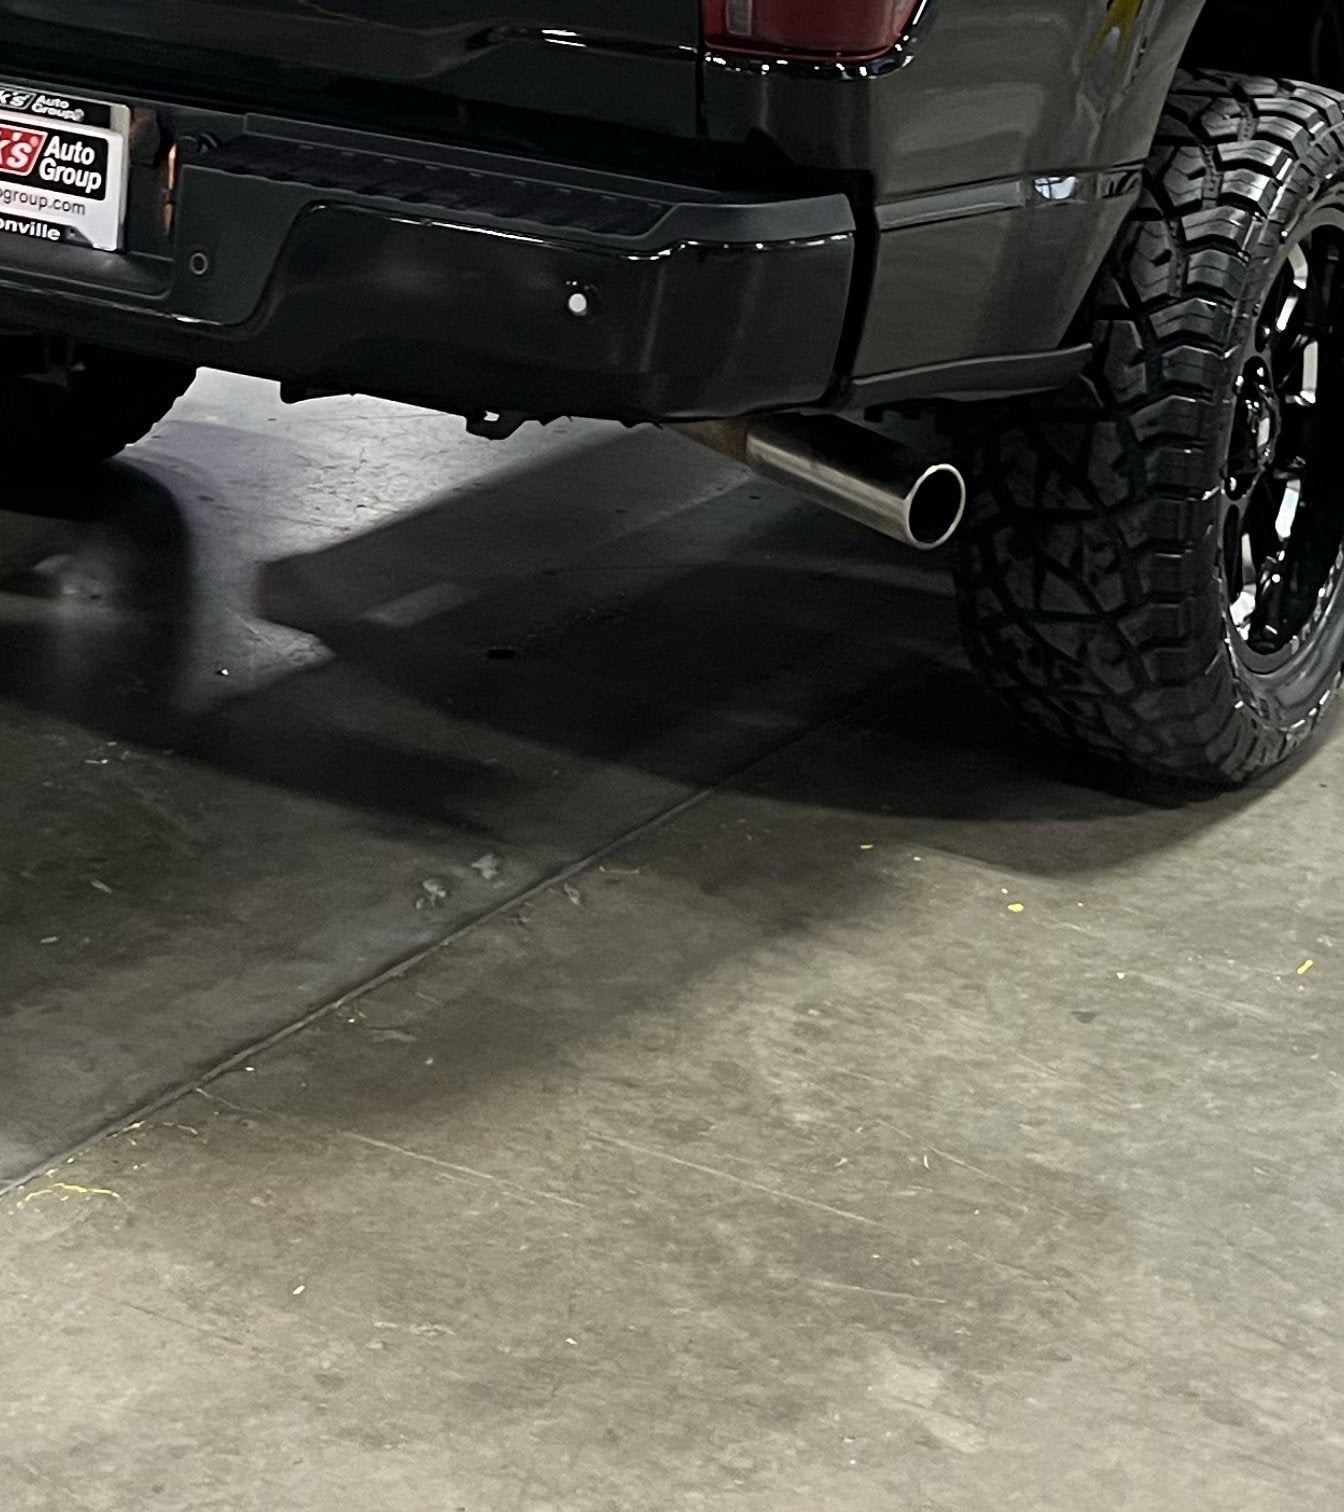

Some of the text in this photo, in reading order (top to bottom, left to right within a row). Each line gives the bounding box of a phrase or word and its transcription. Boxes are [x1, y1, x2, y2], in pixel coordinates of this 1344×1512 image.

[35, 95, 70, 109] Auto
[43, 135, 96, 165] Auto
[39, 158, 102, 194] Group
